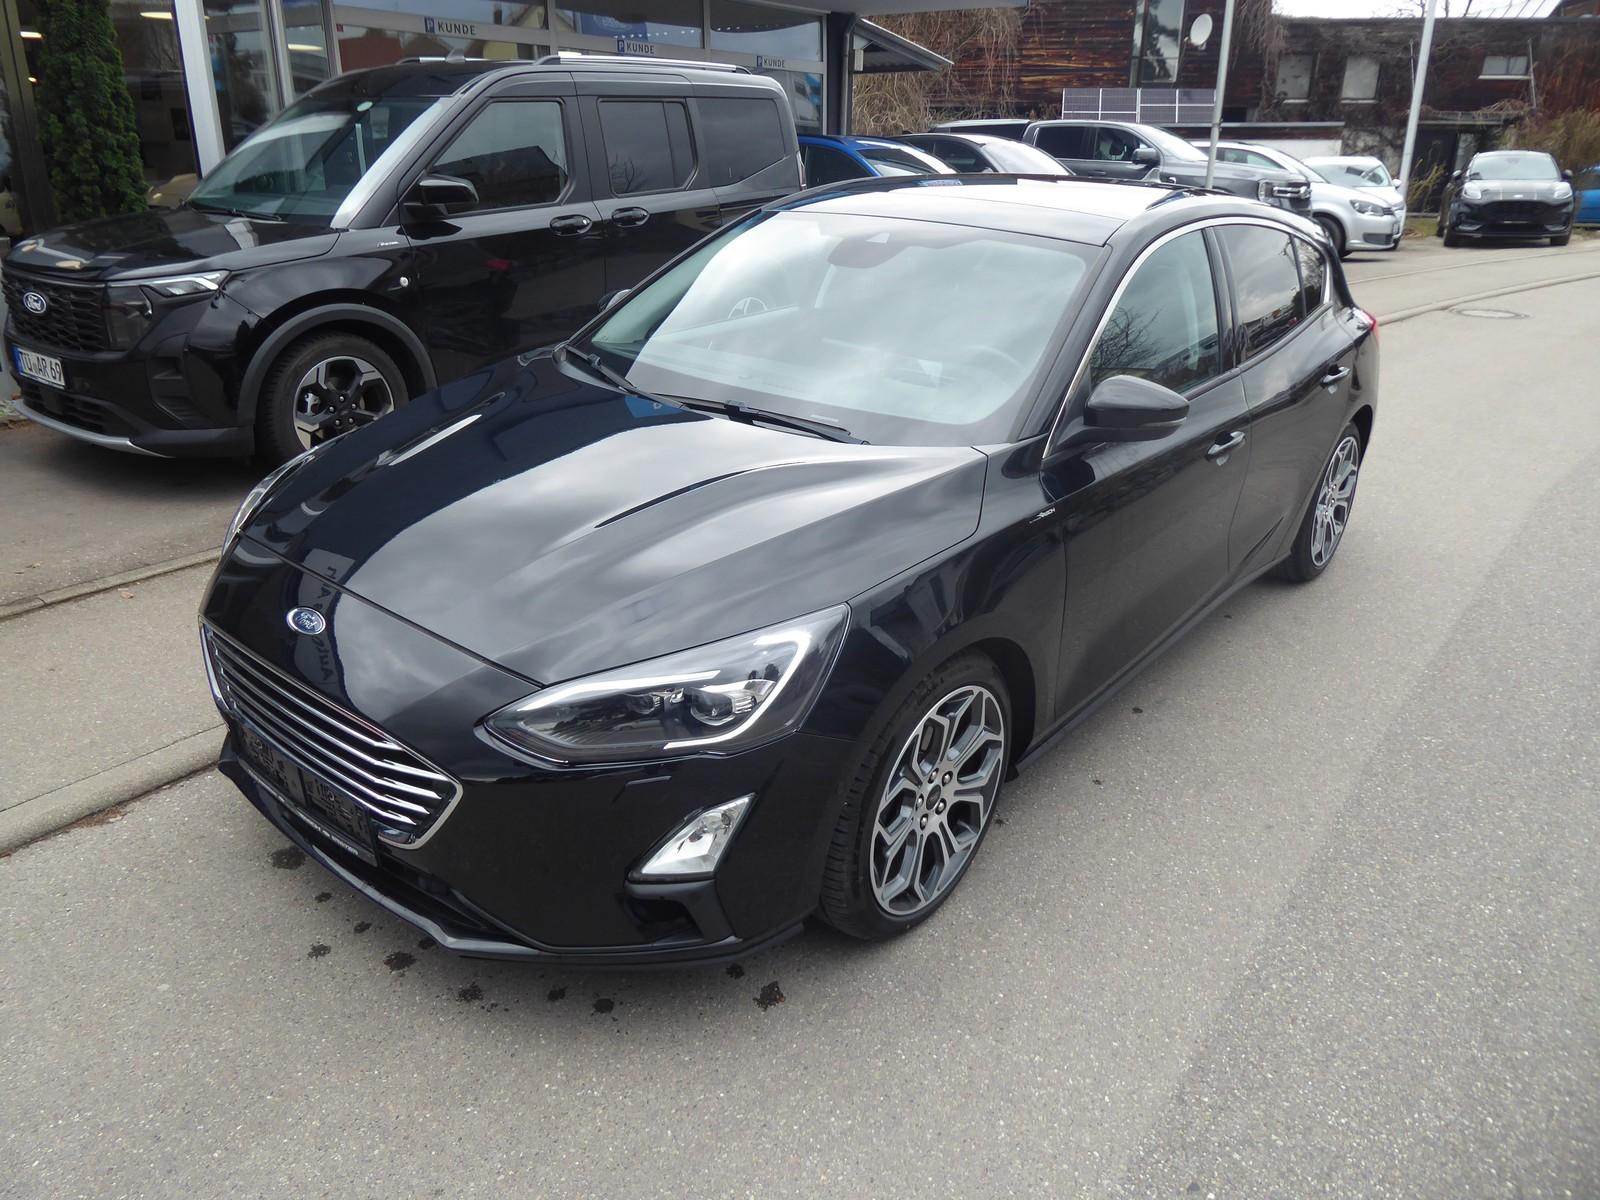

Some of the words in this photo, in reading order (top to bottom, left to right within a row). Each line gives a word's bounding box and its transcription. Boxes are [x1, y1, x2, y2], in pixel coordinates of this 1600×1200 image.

[438, 19, 476, 35] KUNDE
[627, 42, 655, 54] KUNDE
[764, 57, 785, 68] KUNDE
[37, 356, 50, 379] AR
[50, 360, 62, 382] 69
